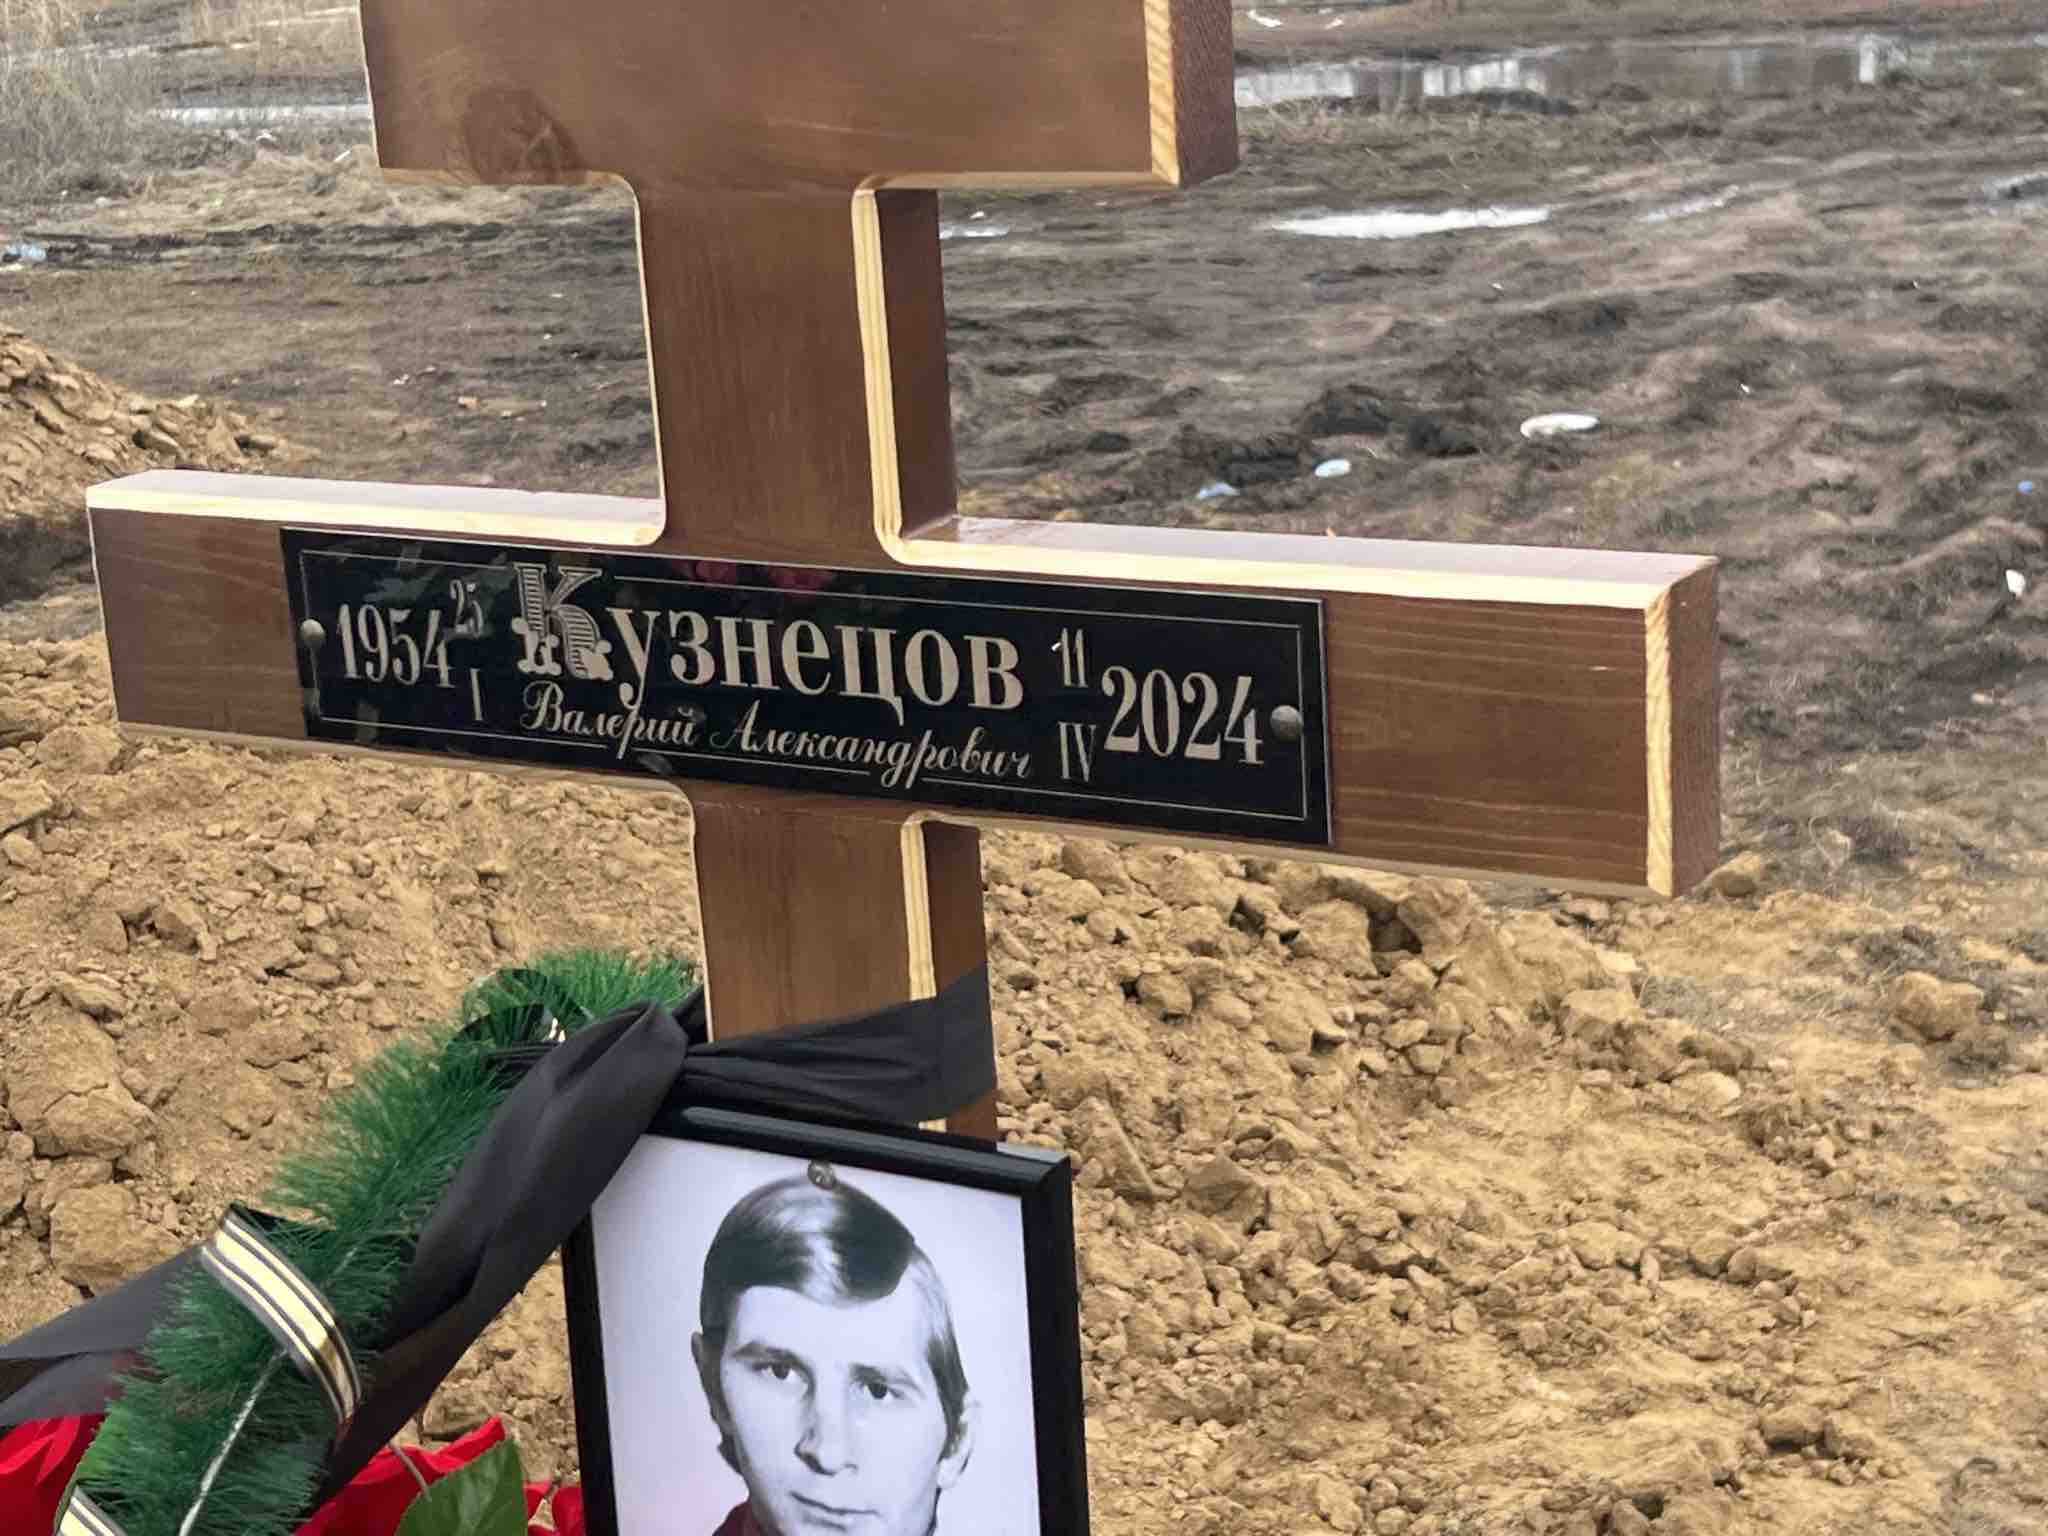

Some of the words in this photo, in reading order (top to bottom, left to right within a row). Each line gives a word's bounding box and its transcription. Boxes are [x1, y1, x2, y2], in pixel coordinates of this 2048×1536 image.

[337, 604, 456, 688] 1954
[450, 579, 484, 636] 25
[511, 562, 1024, 726] Кузнецов
[1051, 627, 1088, 689] 11
[520, 680, 698, 760] Валерий
[709, 699, 1034, 790] Александрович
[1057, 721, 1097, 783] IV
[1101, 665, 1266, 765] 2024
